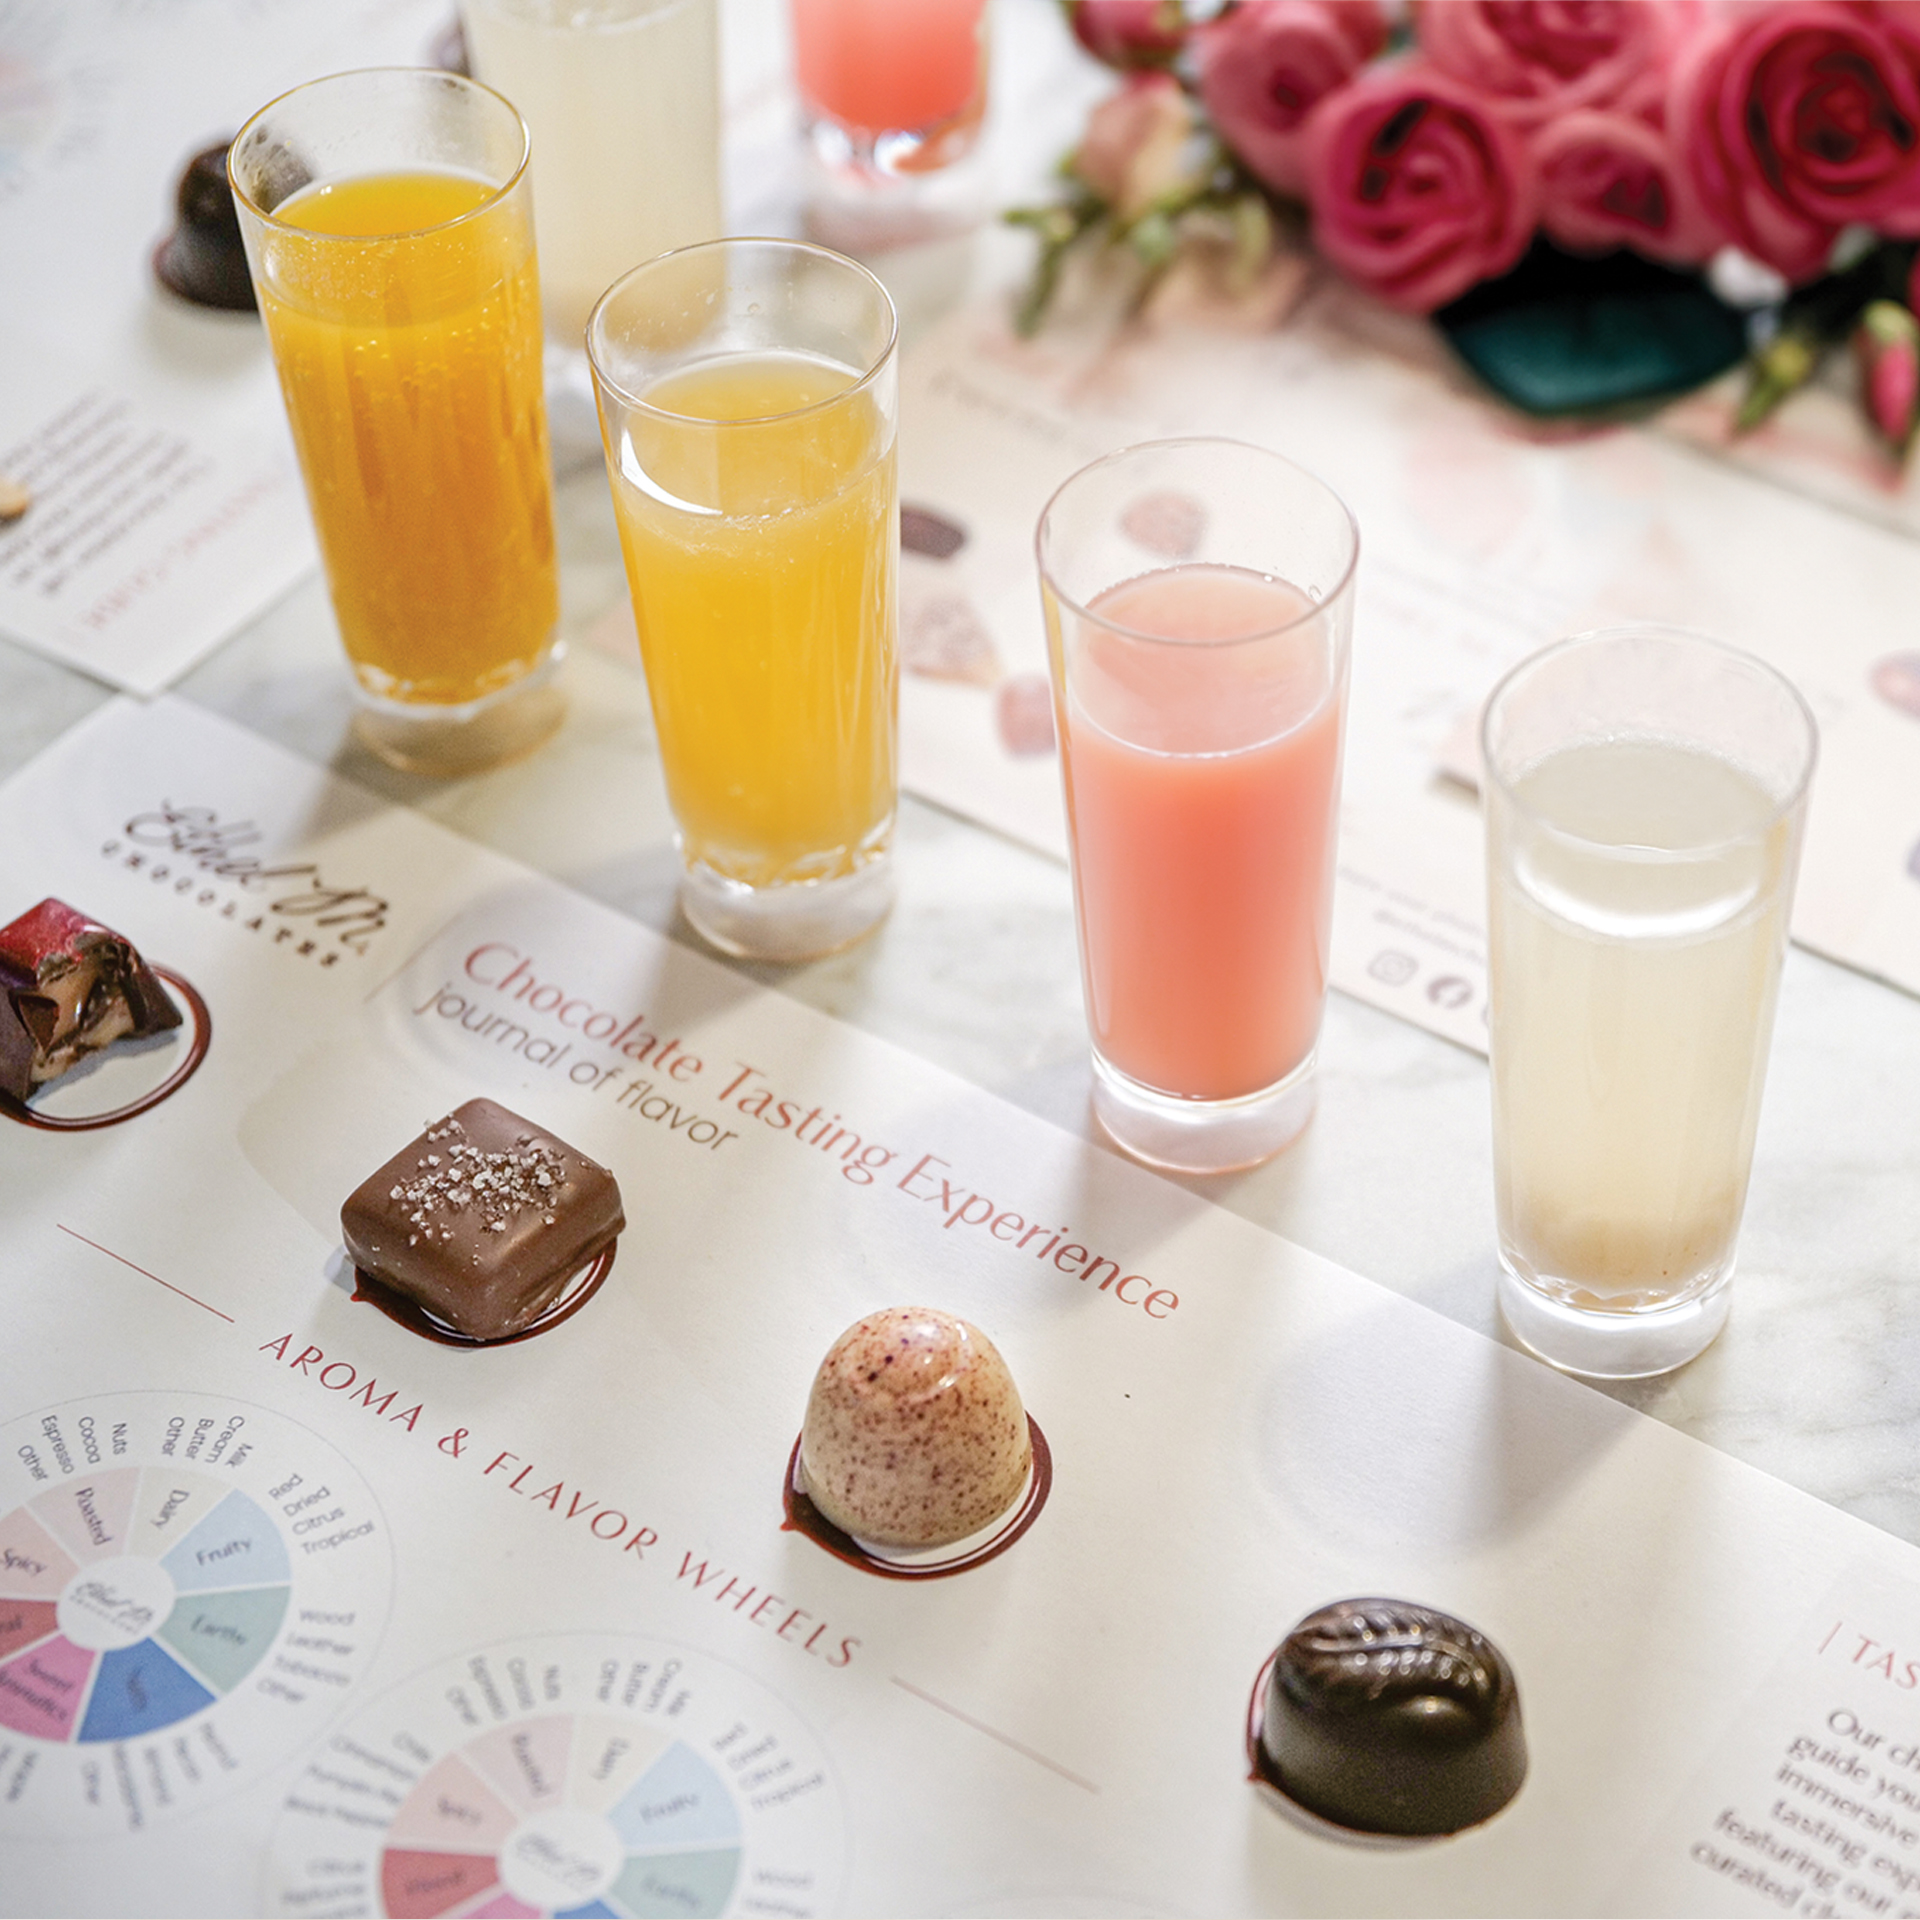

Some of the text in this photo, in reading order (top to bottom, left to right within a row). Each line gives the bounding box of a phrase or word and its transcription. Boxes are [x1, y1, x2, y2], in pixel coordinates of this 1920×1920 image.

[101, 838, 340, 968] CHOCOLATES
[412, 980, 739, 1151] journal of flavor
[463, 941, 1181, 1320] Chocolate Tasting Experience
[40, 1414, 75, 1475] Espresso
[78, 1416, 101, 1464] Cocoa
[112, 1422, 128, 1455] Nuts
[161, 1416, 185, 1457] Other
[185, 1418, 215, 1460] Butter
[204, 1415, 246, 1464] Cream
[17, 1444, 48, 1482] Other
[268, 1472, 304, 1500] Red
[258, 1332, 863, 1669] AROMA & FLAVOR WHEELS
[282, 1485, 331, 1518] Dried
[292, 1506, 346, 1536] Citrus
[195, 1538, 252, 1577] Fruity
[300, 1520, 376, 1556] Tropical
[1826, 1706, 1886, 1750] Our
[1786, 1735, 1870, 1784] guide
[1775, 1762, 1919, 1847] immersive
[1714, 1807, 1843, 1896] featuring
[1770, 1799, 1867, 1870] tasting
